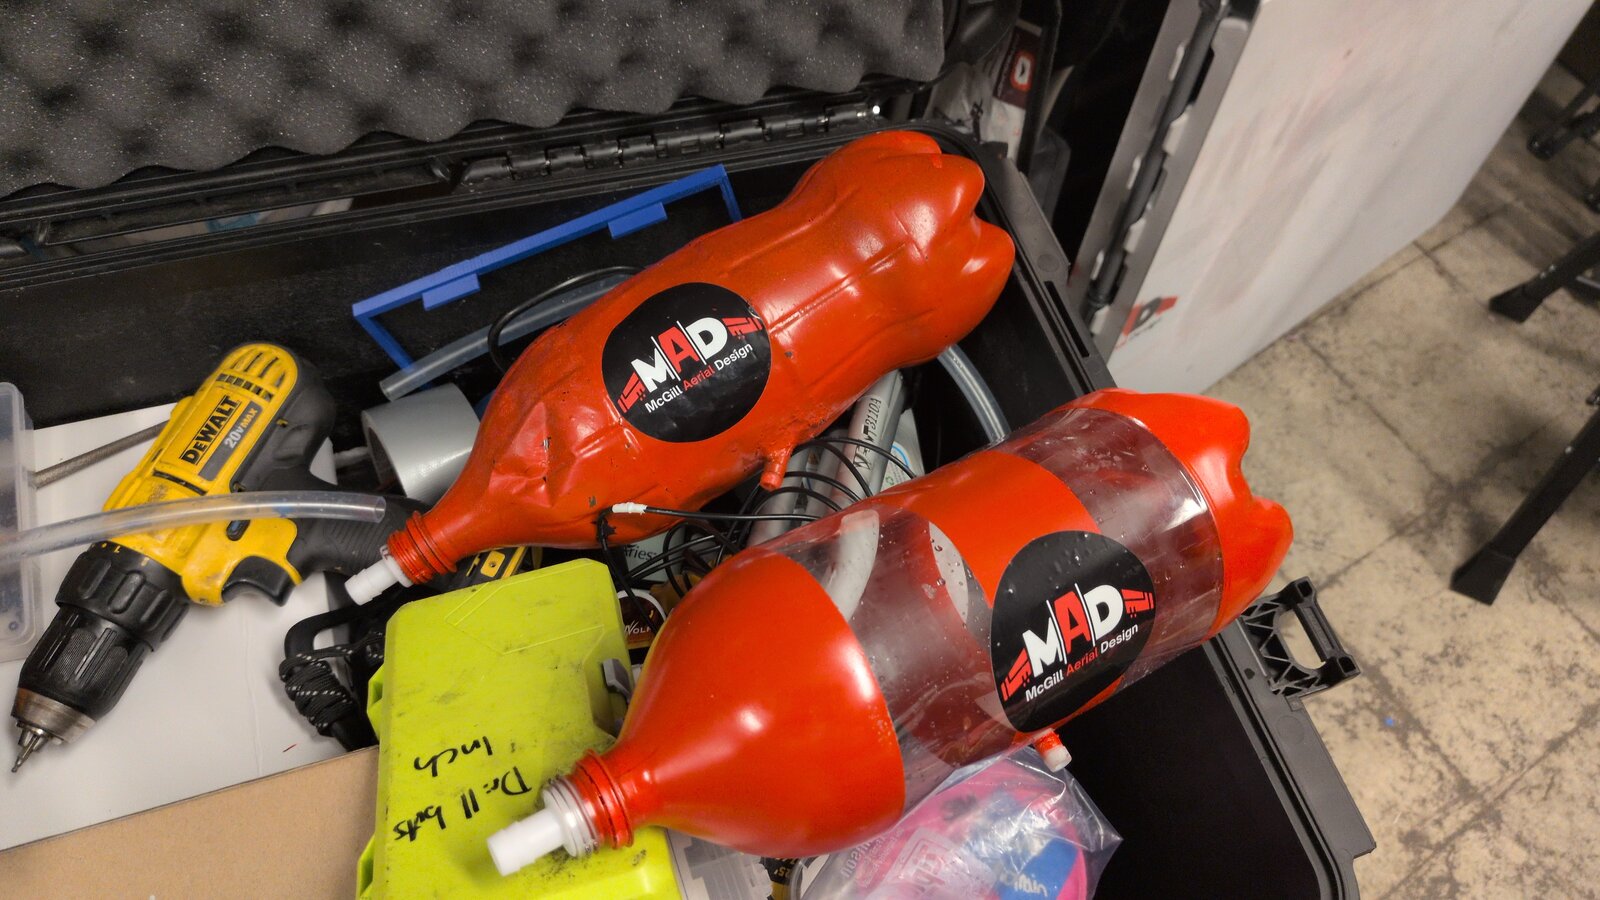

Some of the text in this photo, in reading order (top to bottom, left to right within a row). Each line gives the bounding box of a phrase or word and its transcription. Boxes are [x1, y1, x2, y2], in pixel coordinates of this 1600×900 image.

[630, 317, 728, 393] MAD
[644, 343, 753, 413] McGill Aerial Design
[181, 394, 238, 465] DEWALT
[1022, 584, 1124, 678] MAD
[1024, 624, 1139, 702] McGill Aerial Design
[461, 766, 533, 820] Drill
